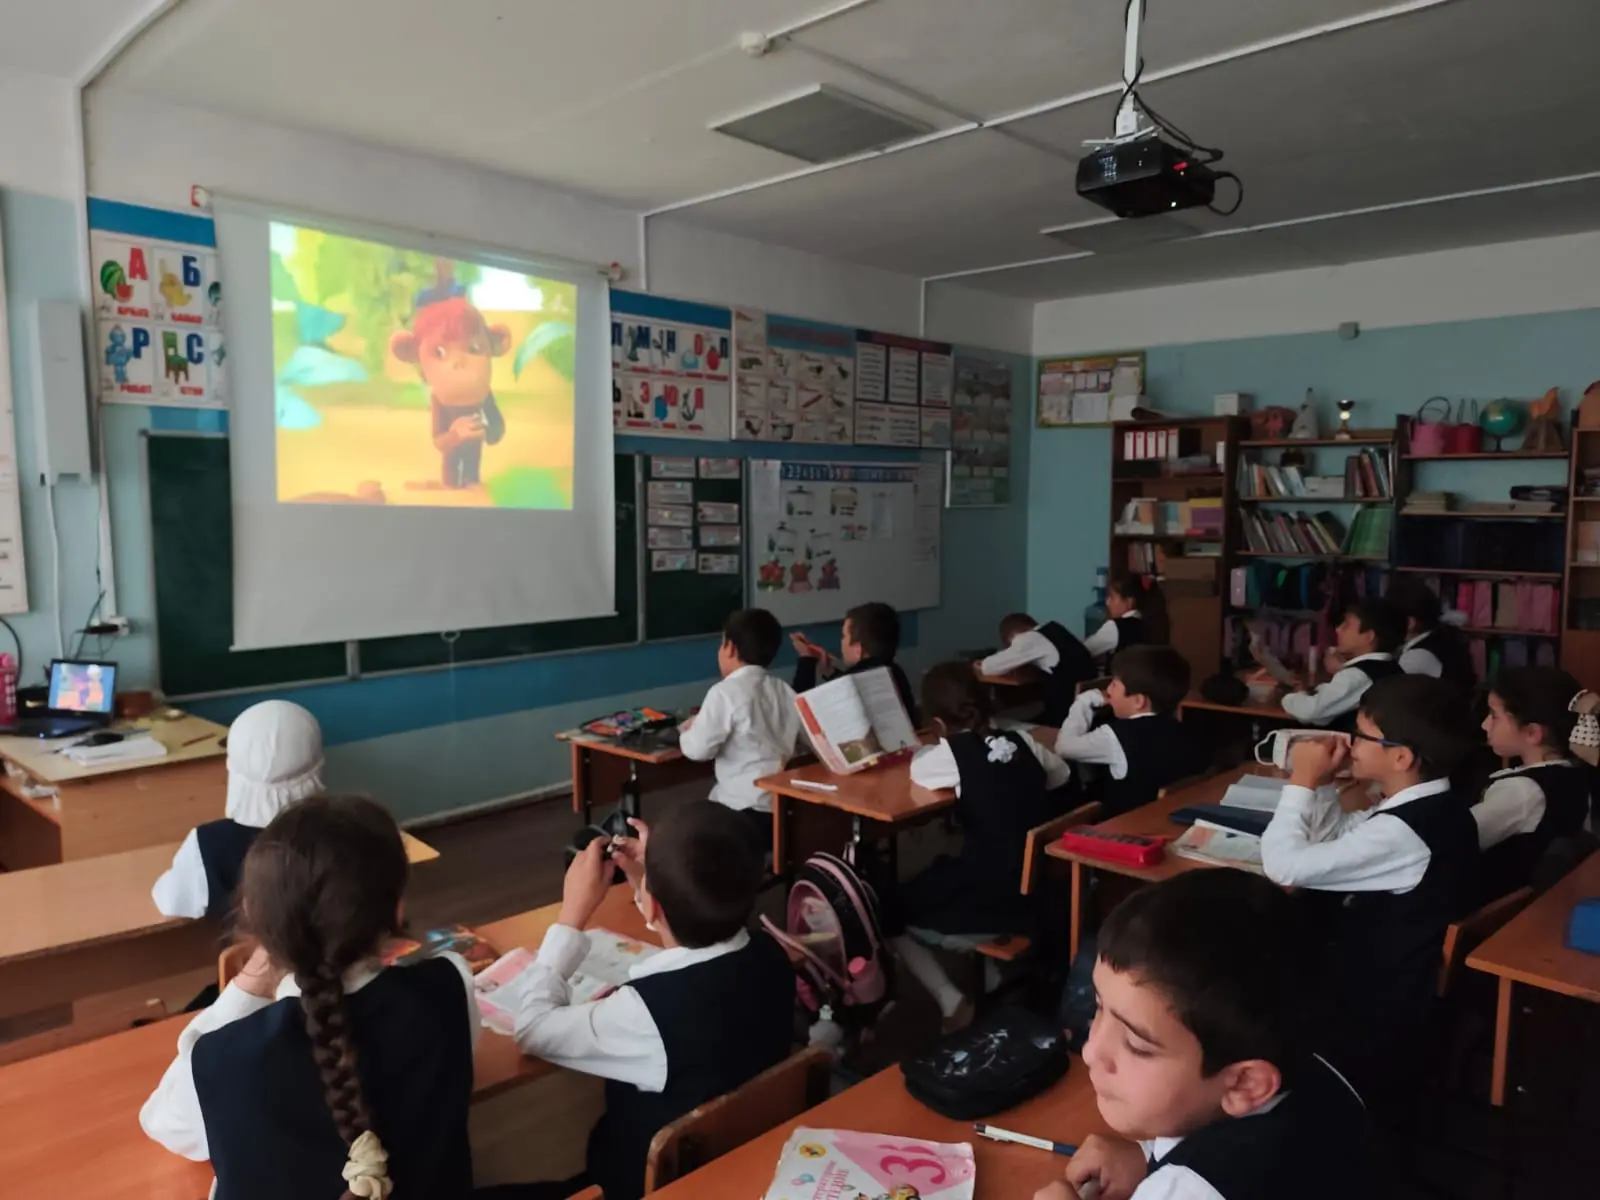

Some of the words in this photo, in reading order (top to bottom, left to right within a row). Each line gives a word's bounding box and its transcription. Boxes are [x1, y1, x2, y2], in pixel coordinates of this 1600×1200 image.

[129, 247, 148, 280] А
[182, 255, 200, 286] Б
[132, 327, 149, 358] Р
[187, 334, 203, 364] С
